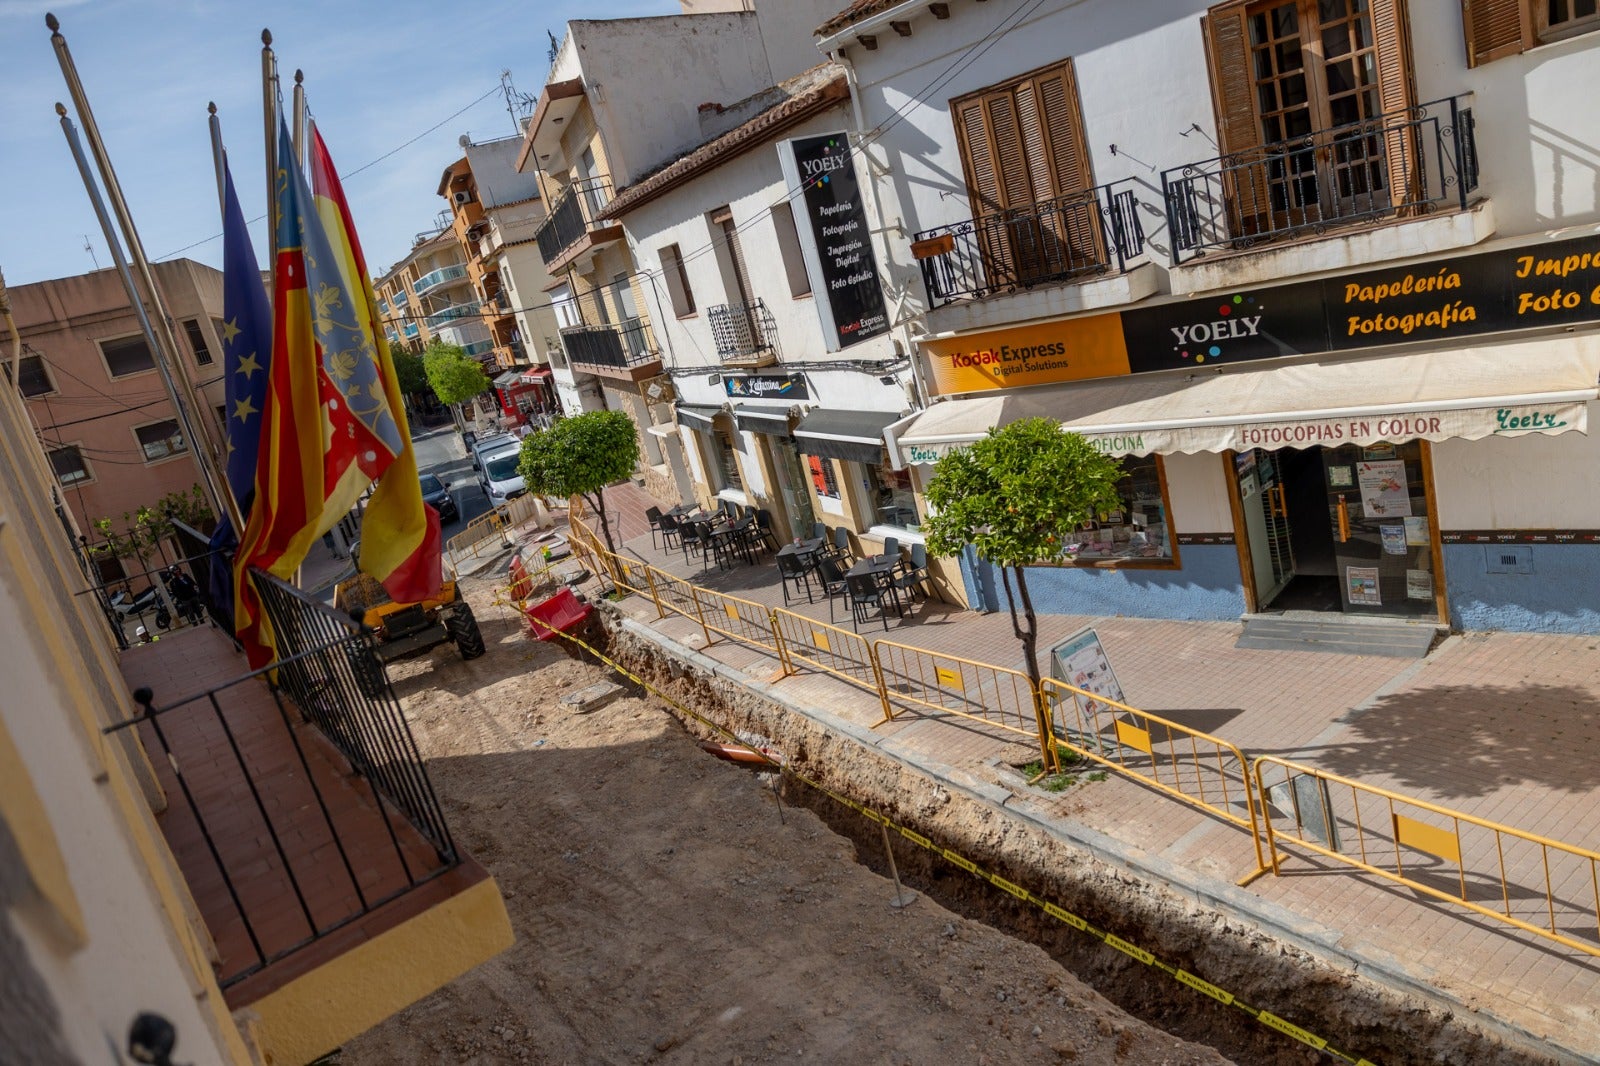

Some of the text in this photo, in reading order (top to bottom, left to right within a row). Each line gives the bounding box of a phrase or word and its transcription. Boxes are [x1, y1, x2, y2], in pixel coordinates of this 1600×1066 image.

[802, 154, 844, 175] YOELY
[819, 200, 852, 216] Papelería
[822, 220, 858, 237] Fotografía
[827, 240, 862, 256] Impresión
[835, 253, 860, 268] Digital
[831, 278, 847, 290] Foto
[1345, 267, 1461, 304] Papelería
[1518, 289, 1581, 315] Foto
[1347, 301, 1477, 336] Fotografía
[1171, 315, 1263, 346] YOELY
[993, 359, 1069, 377] Digital Solutions
[1242, 417, 1441, 444] FOTOCOPIAS EN COLOR
